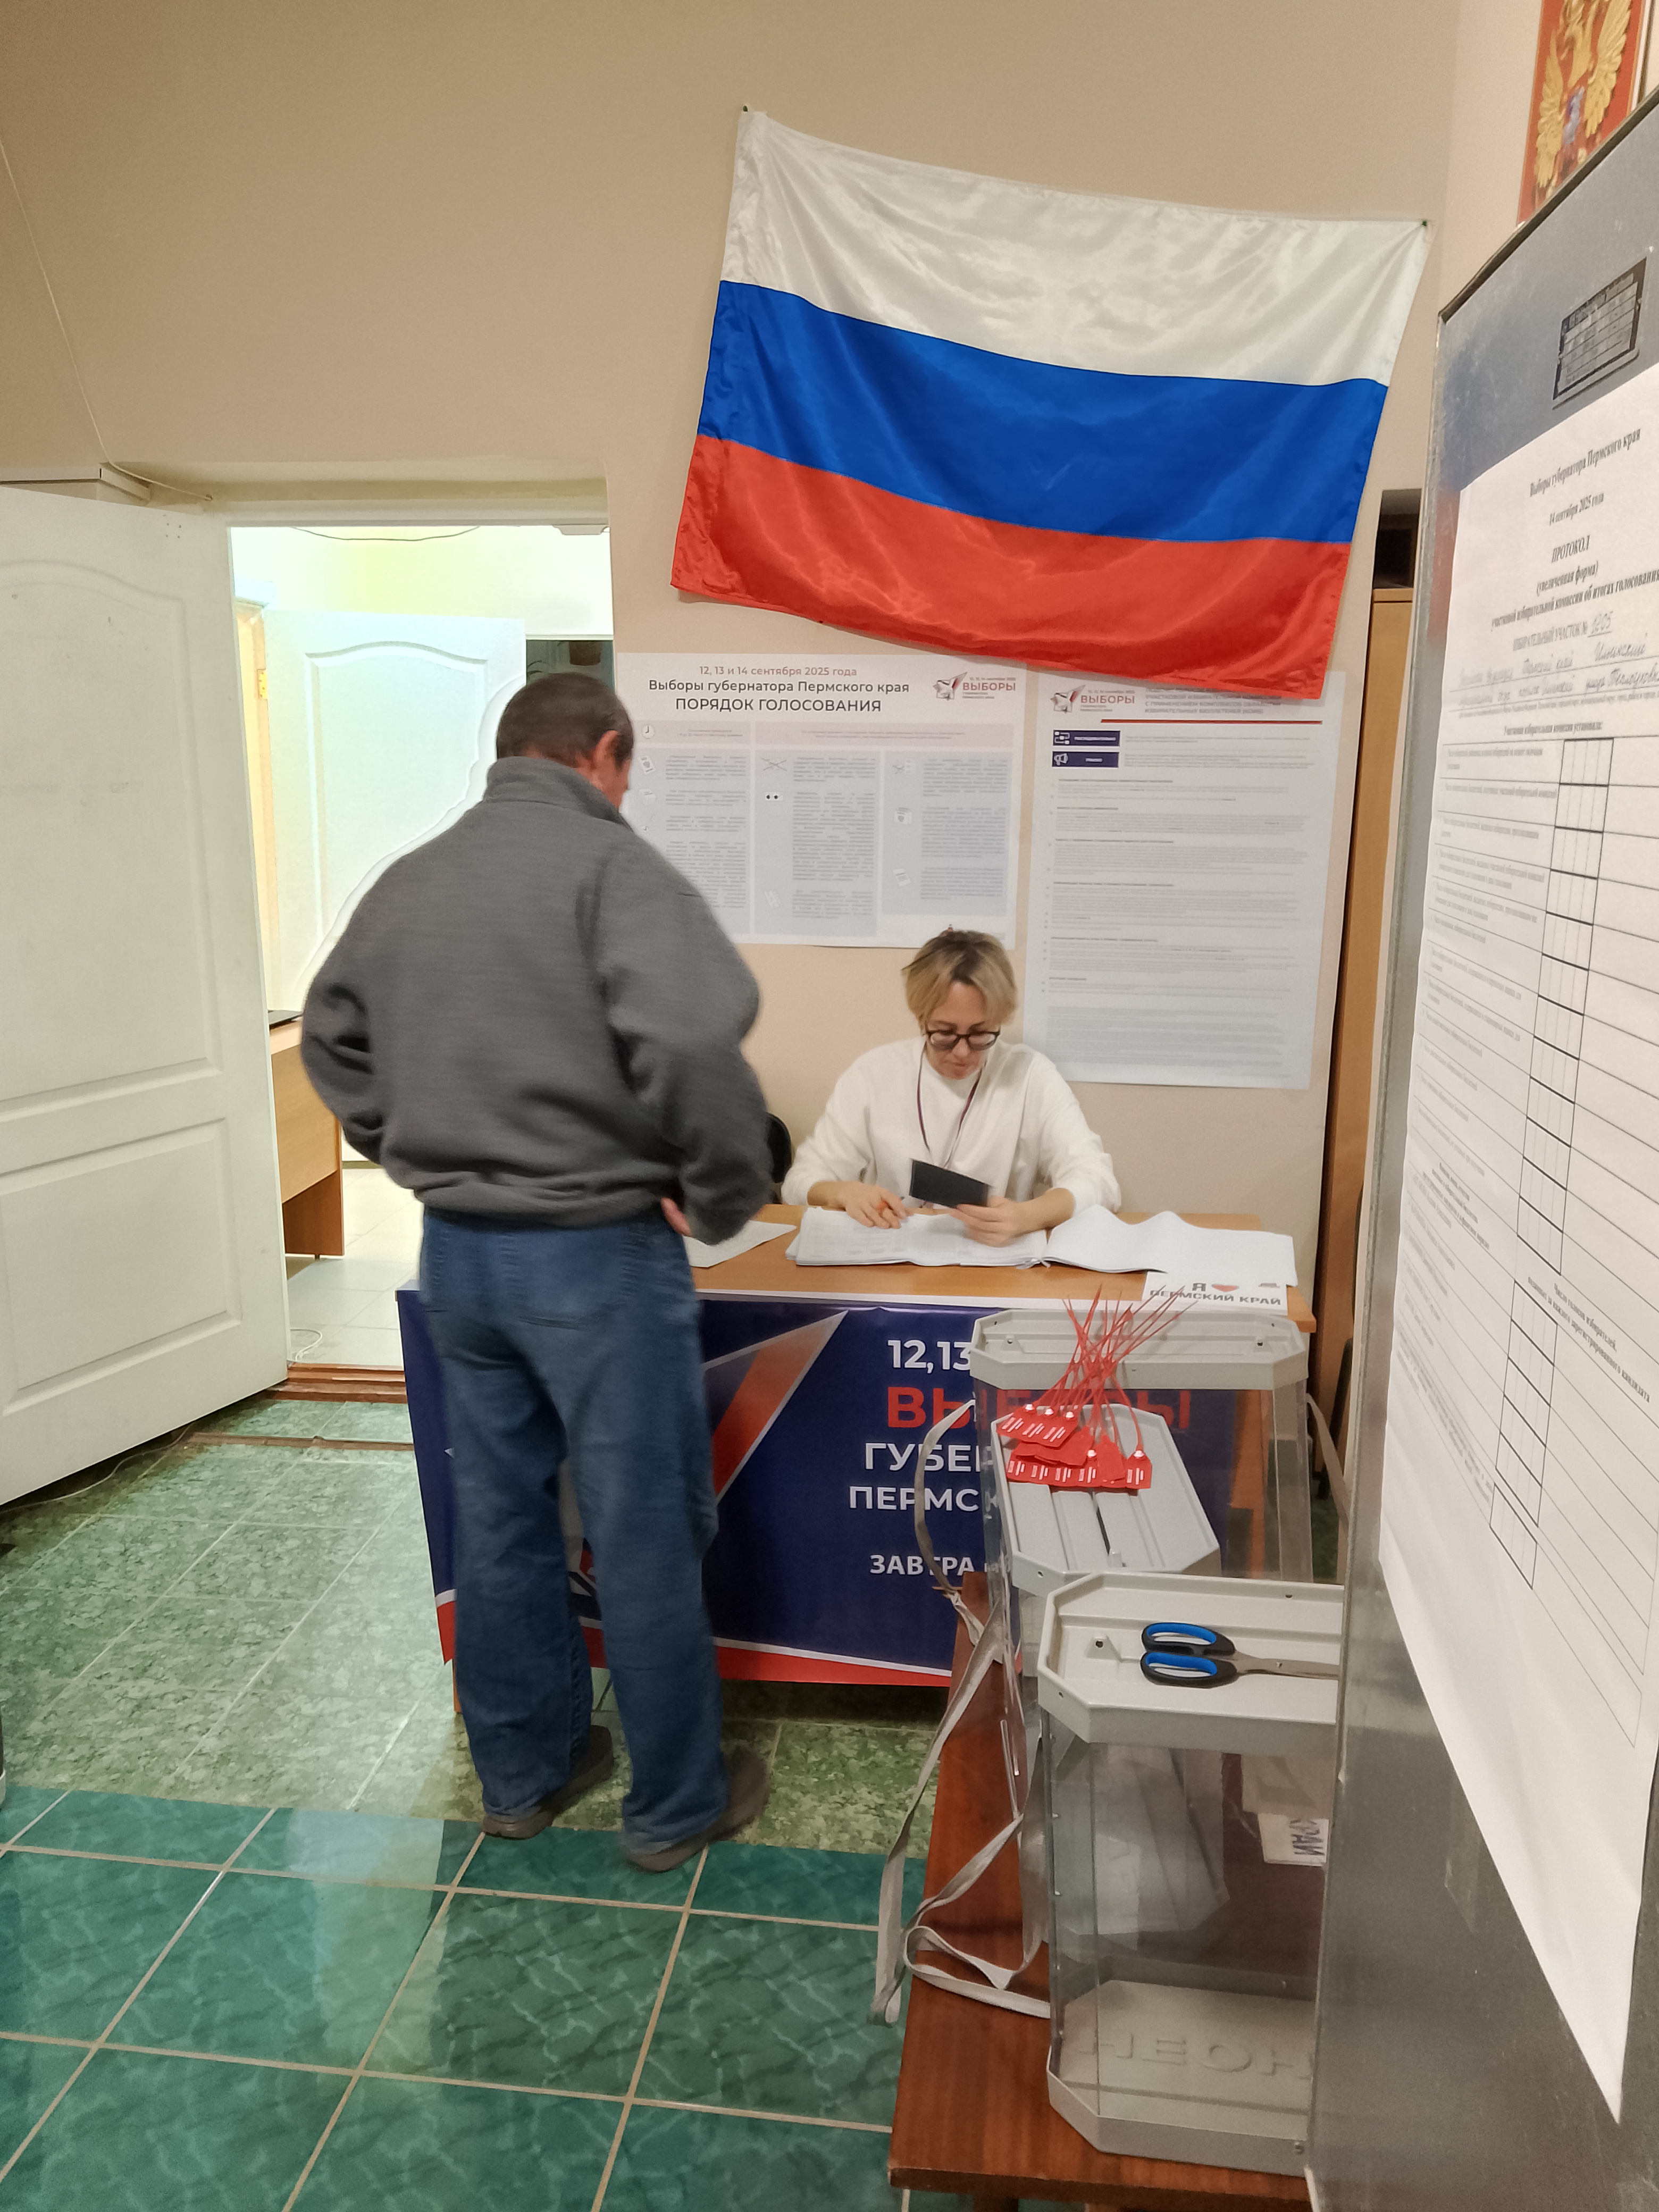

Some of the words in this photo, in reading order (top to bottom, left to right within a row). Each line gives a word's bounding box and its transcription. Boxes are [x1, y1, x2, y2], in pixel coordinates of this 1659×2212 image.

[1552, 458, 1586, 488] губернатора
[1587, 439, 1622, 468] Пермского
[1623, 428, 1641, 451] края
[1549, 513, 1555, 526] 14
[1579, 495, 1592, 512] 2025
[1591, 493, 1604, 507] года
[1551, 534, 1590, 564] ПРОТОКОЛ
[1575, 560, 1599, 585] форма)
[1584, 583, 1593, 602] об
[1593, 583, 1614, 599] итогах
[699, 665, 712, 676] 12,
[714, 666, 725, 675] 13
[736, 666, 748, 675] 14
[751, 666, 802, 677] сентября
[804, 667, 830, 676] 2025
[648, 679, 704, 693] Выборы
[708, 680, 794, 694] губернатора
[798, 681, 874, 694] Пермского
[877, 683, 909, 694] края
[962, 682, 1016, 691] ВЫБОРЫ
[675, 698, 754, 713] ПОРЯДОК
[759, 699, 882, 712] ГОЛОСОВАНИЯ
[1080, 695, 1135, 704] ВЫБОРЫ
[1192, 1282, 1207, 1292] Я
[1239, 1296, 1281, 1305] КРАЙ
